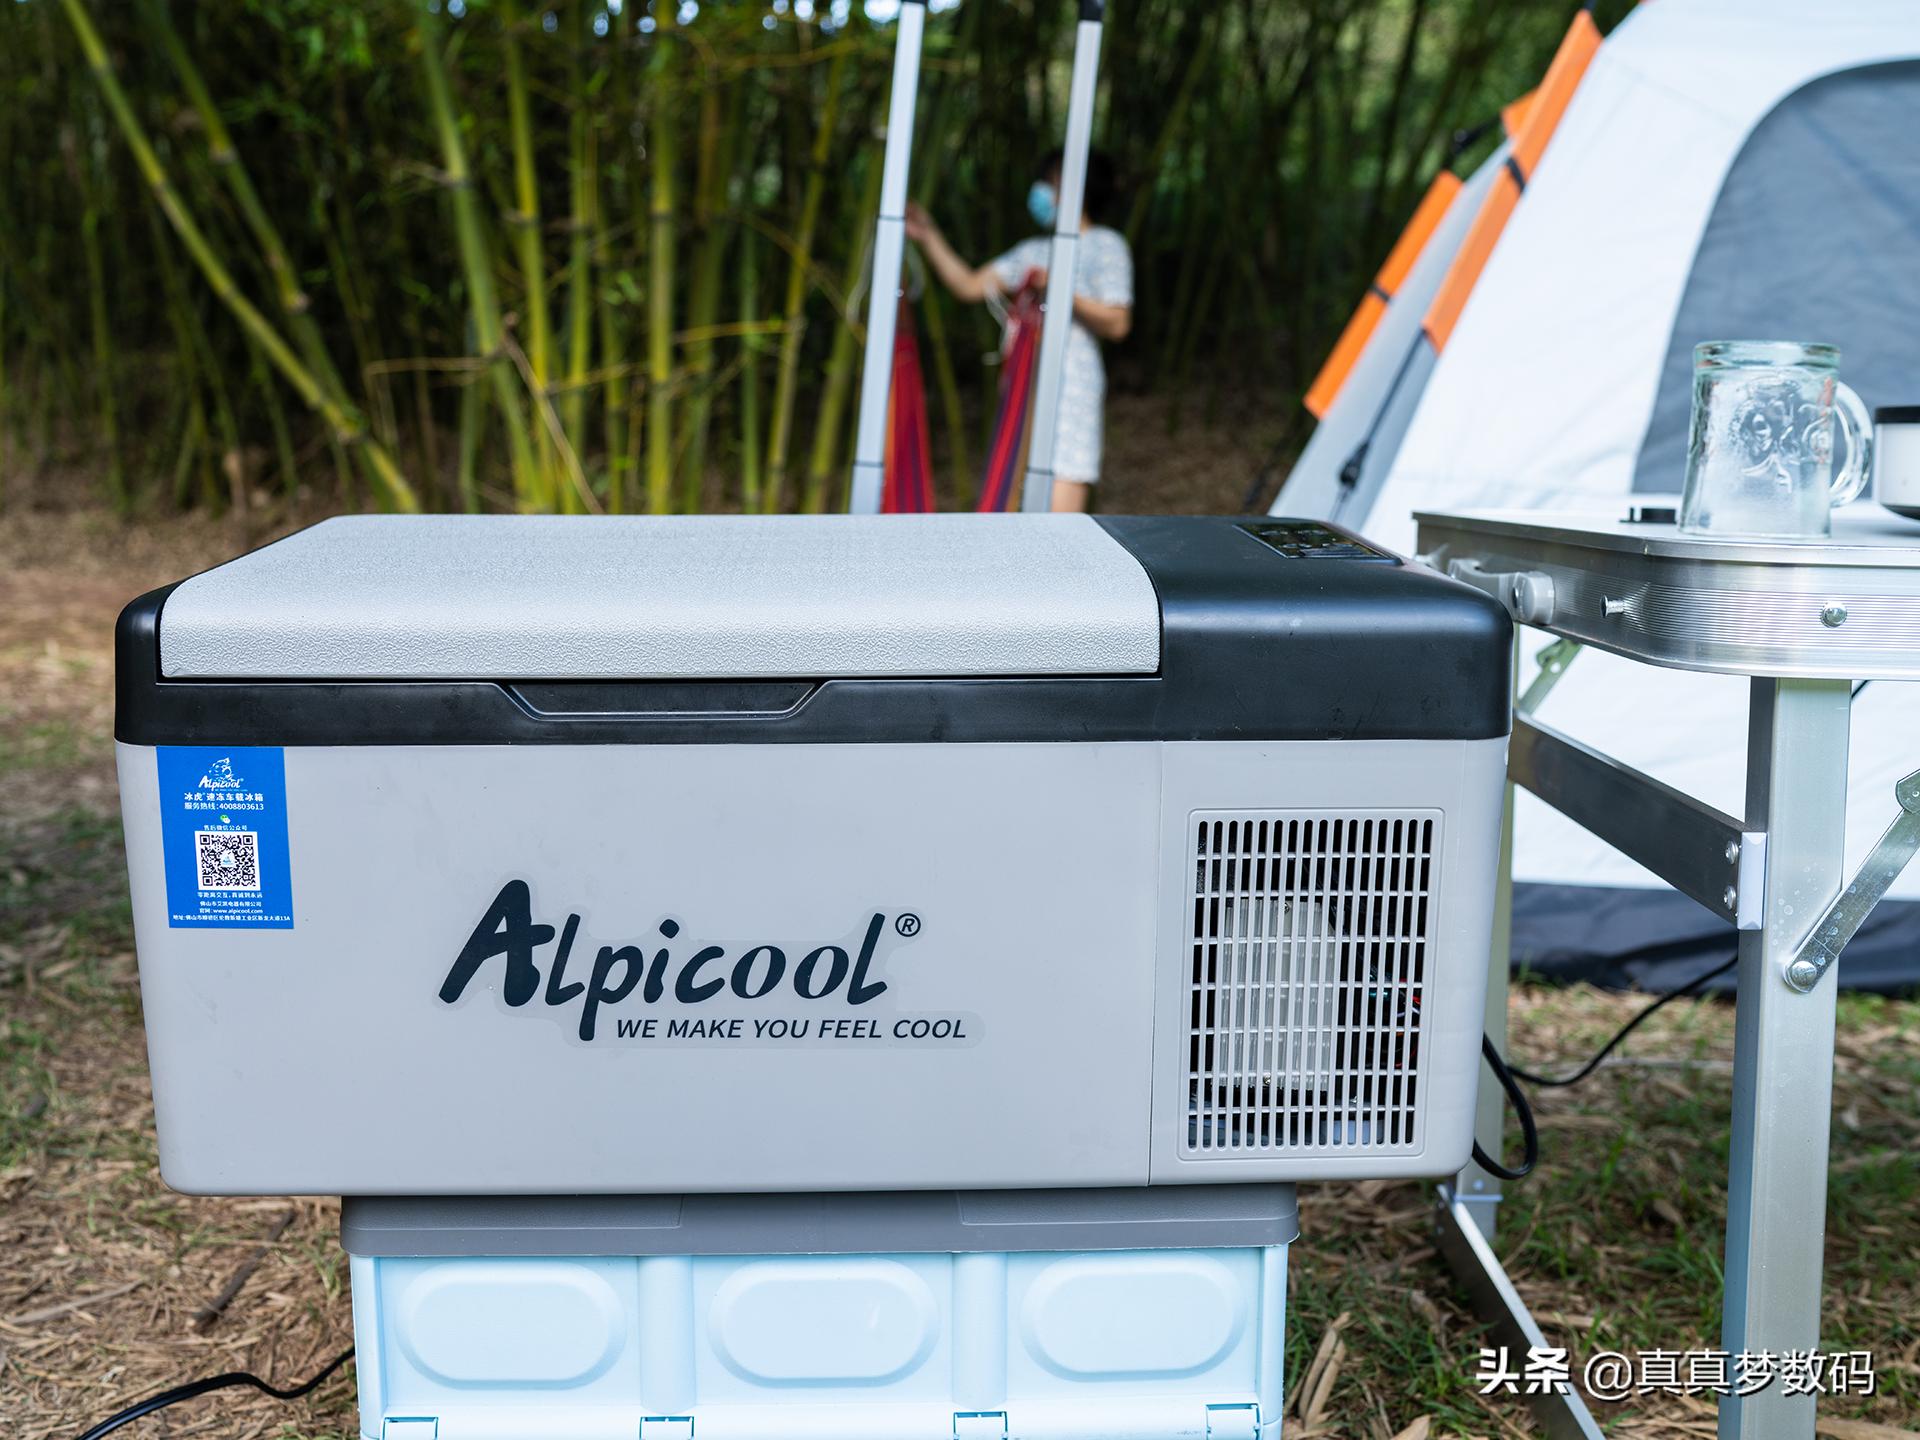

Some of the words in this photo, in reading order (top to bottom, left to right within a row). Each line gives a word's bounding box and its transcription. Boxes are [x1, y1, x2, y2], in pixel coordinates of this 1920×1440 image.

[616, 1018, 658, 1039] WE
[666, 1018, 744, 1039] MAKE
[753, 1018, 810, 1039] YOU
[818, 1018, 882, 1039] FEEL
[892, 1018, 967, 1039] COOL
